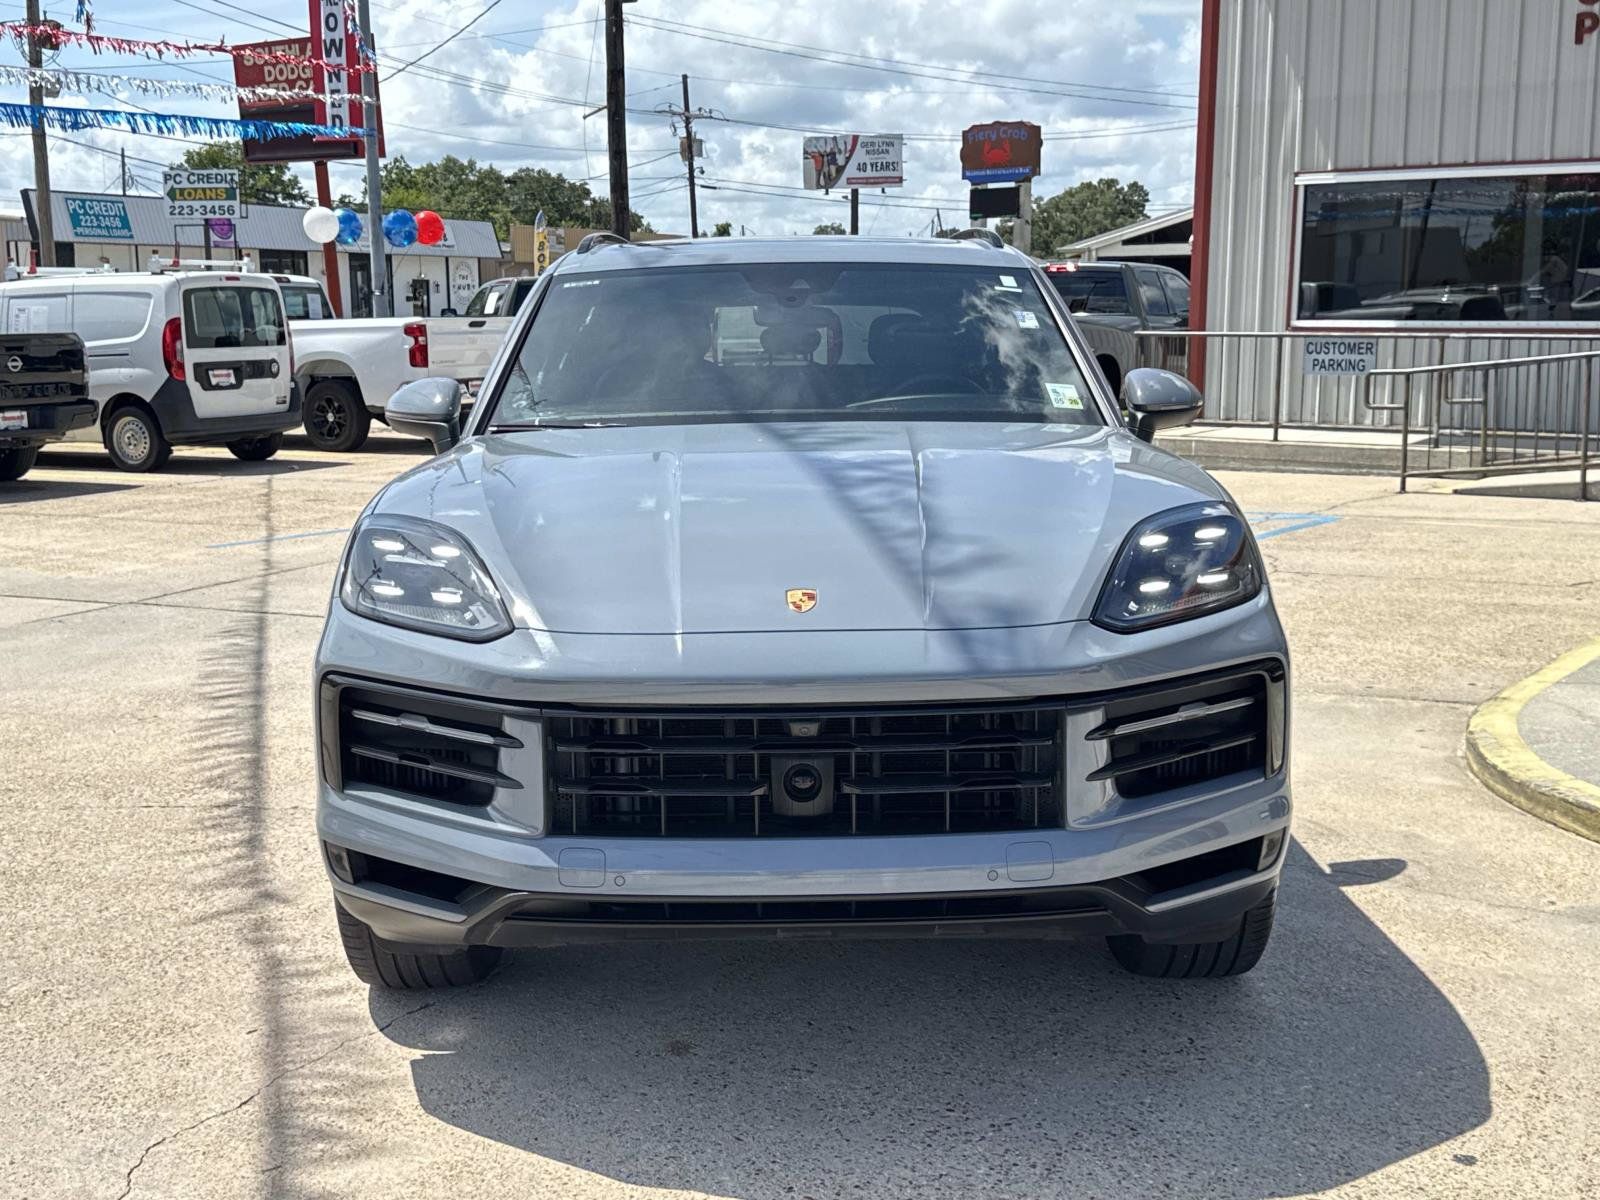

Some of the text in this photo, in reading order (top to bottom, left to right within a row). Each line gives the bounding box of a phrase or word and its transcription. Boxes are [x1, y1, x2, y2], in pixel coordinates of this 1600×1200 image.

[865, 148, 890, 156] NISSAN
[856, 161, 899, 173] 40 YEARS!
[163, 172, 236, 185] PC CREDIT
[175, 188, 226, 200] LOANS
[67, 199, 125, 216] PC CREDIT
[1306, 341, 1374, 356] CUSTOMER
[1311, 358, 1367, 373] PARKING
